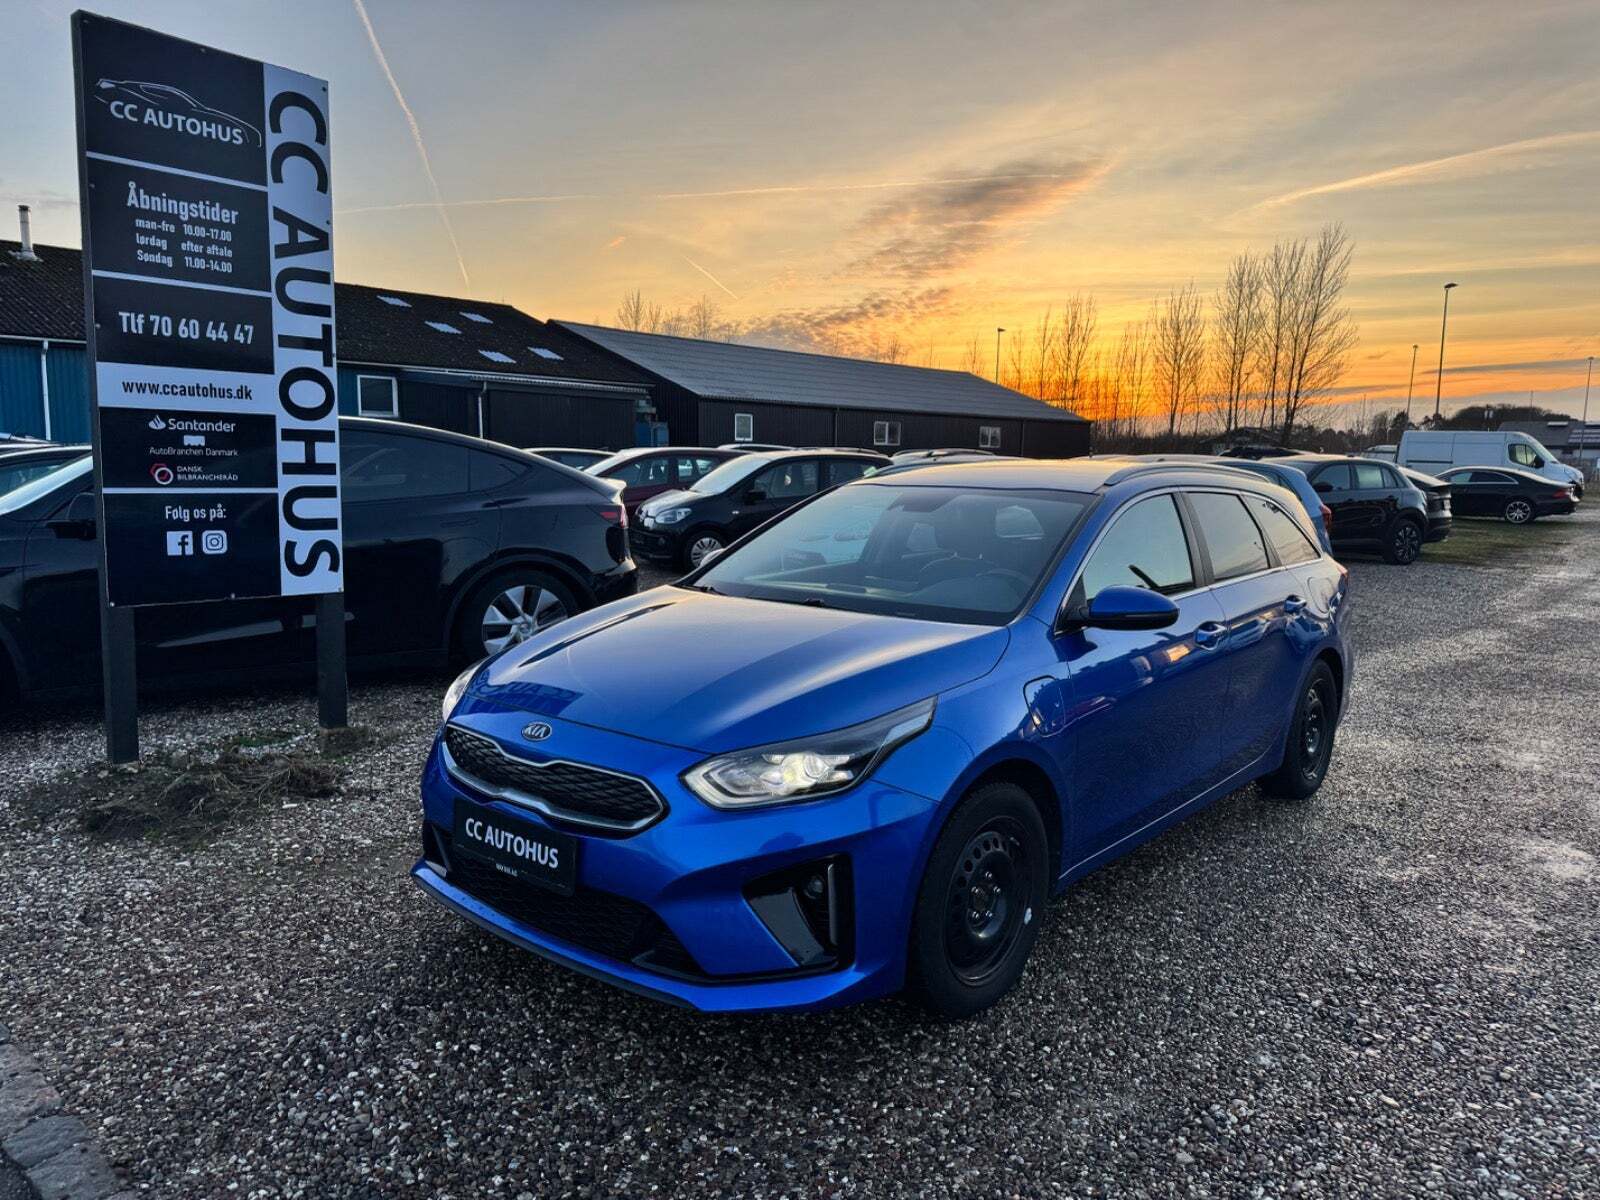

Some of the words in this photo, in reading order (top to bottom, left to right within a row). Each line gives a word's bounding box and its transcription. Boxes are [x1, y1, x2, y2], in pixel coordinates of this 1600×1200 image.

[109, 100, 138, 122] CC
[143, 107, 244, 146] AUTOHUS
[269, 90, 328, 195] CC
[127, 181, 239, 224] Åbningstider
[135, 218, 176, 233] man-fre
[183, 223, 232, 242] 10.00-17.00
[136, 233, 168, 250] lørdag
[181, 240, 204, 253] efter
[206, 244, 233, 257] aftale
[137, 249, 173, 267] Søndag
[184, 256, 233, 273] 11.00-14.00
[118, 311, 145, 334] Tlf
[150, 316, 172, 337] 70
[178, 318, 199, 340] 60
[206, 323, 229, 343] 44
[234, 325, 254, 345] 47
[122, 380, 253, 401] www.ccautohus.dk
[272, 205, 341, 578] AUTOHUS
[168, 418, 236, 433] Santander
[149, 446, 204, 457] AutoBranchen
[205, 447, 239, 457] Danmark
[177, 465, 203, 473] DANSK
[177, 472, 239, 482] BILBRANCHERÅD
[165, 505, 190, 522] Følg
[193, 508, 207, 519] os
[209, 503, 227, 522] på:
[465, 817, 483, 842] CC
[484, 827, 559, 869] AUTOHUS
